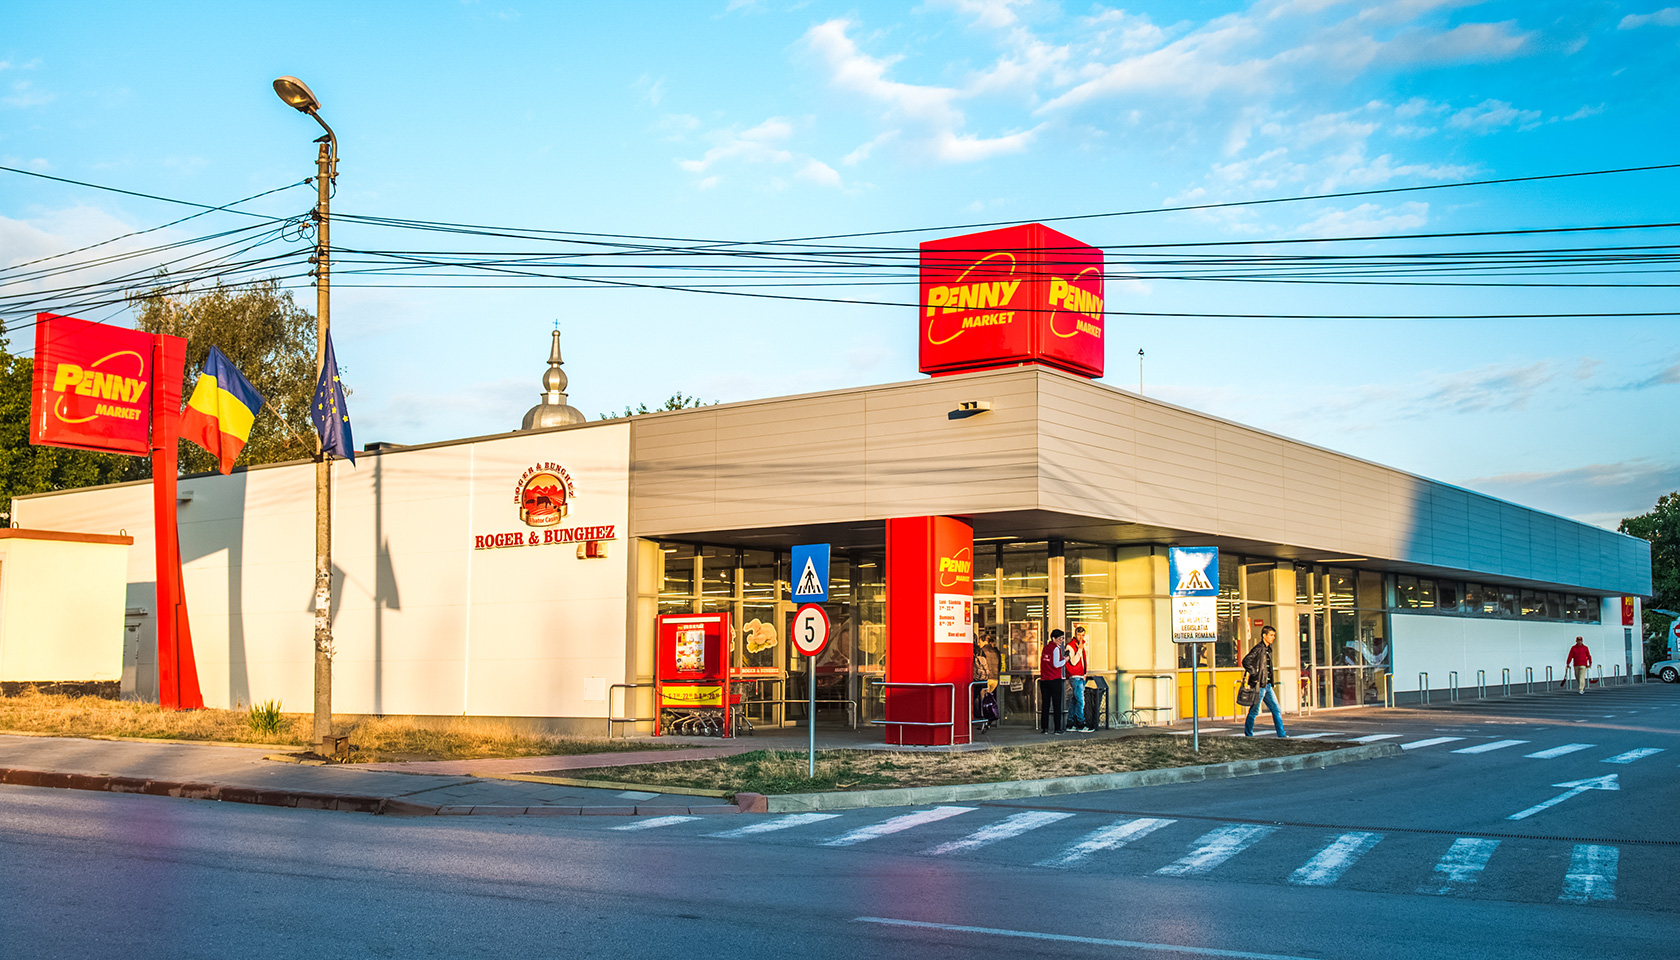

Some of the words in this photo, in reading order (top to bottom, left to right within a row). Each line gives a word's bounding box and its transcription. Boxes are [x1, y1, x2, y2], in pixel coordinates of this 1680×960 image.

[926, 279, 1022, 317] PENNY
[1049, 276, 1103, 321] PENNY
[961, 312, 1015, 329] MARKET
[1076, 320, 1102, 338] MARKET
[53, 363, 147, 402] PENNY
[95, 404, 142, 421] MARKET
[514, 467, 534, 504] ROGER
[536, 462, 541, 470] &
[544, 462, 575, 498] BUNGHEZ
[475, 532, 524, 549] ROGER
[528, 531, 539, 545] &
[544, 525, 615, 544] BUNGHEZ
[939, 557, 971, 574] PENNY
[805, 616, 815, 643] 5
